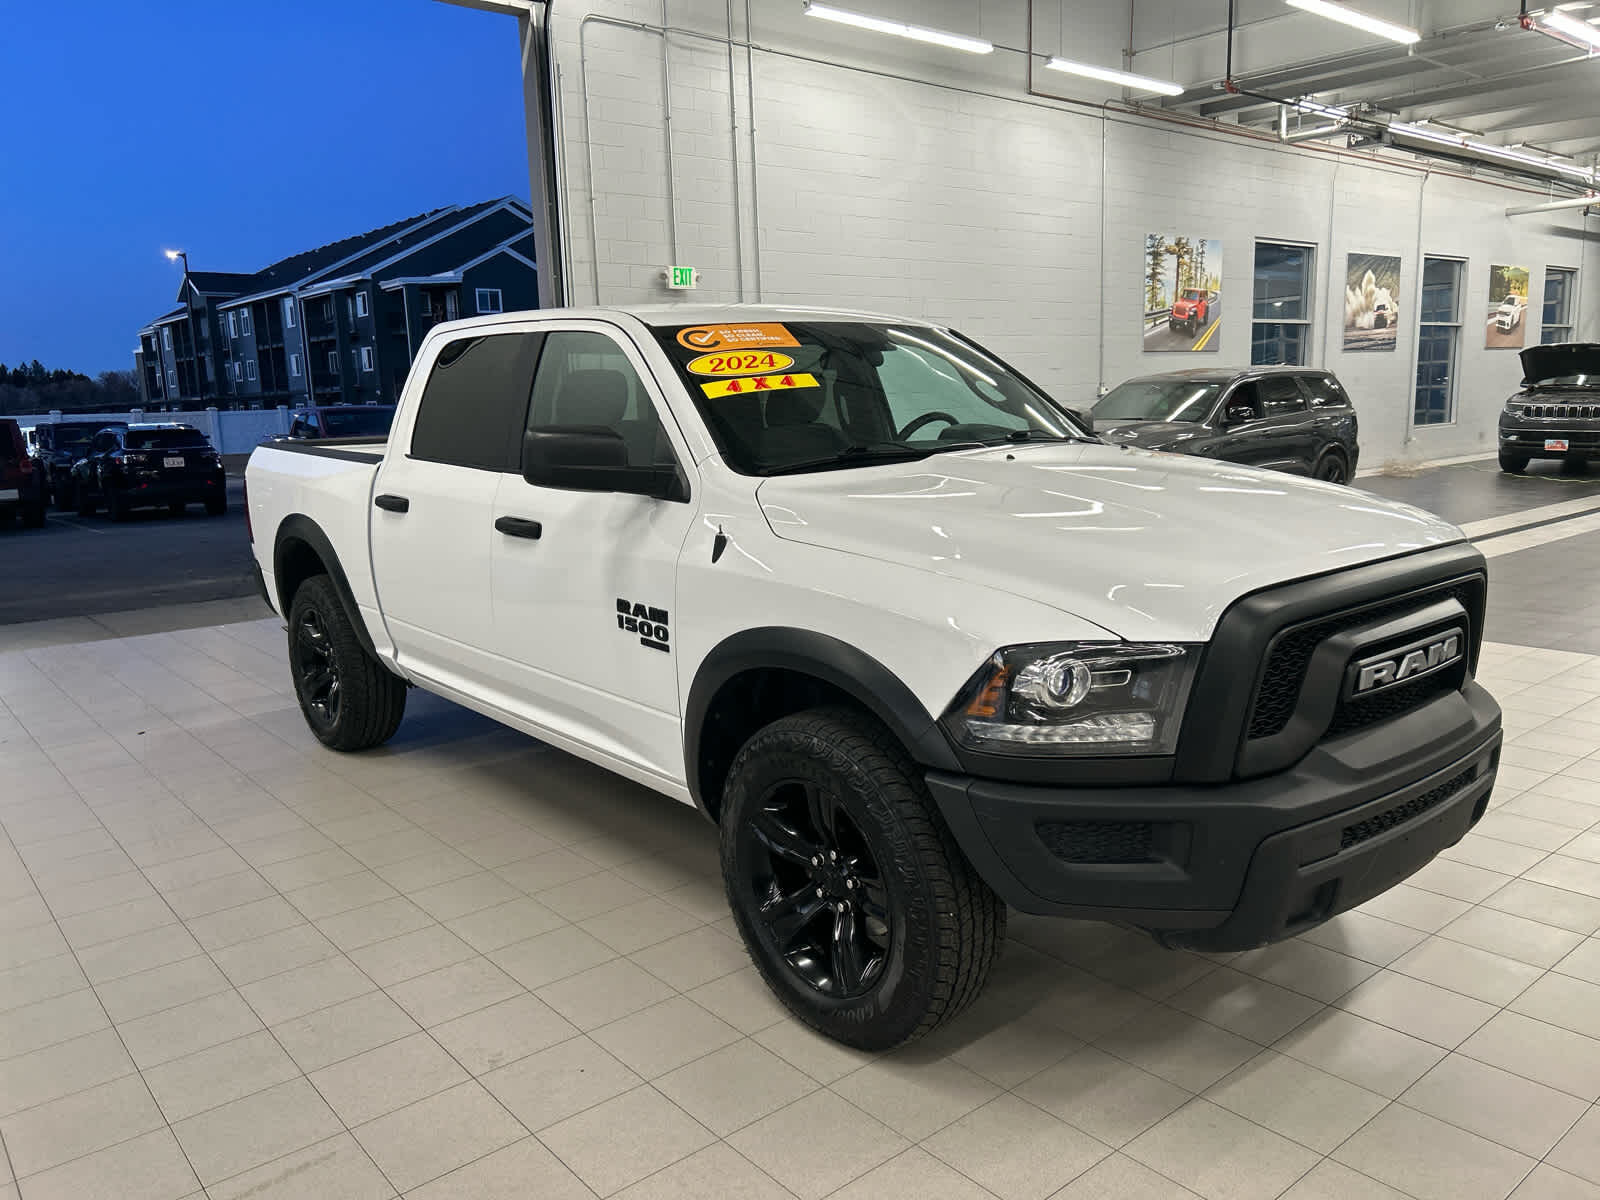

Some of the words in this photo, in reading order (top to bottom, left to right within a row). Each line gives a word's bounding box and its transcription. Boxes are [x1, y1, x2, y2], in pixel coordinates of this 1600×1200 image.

[673, 267, 693, 286] EXIT
[709, 353, 777, 373] 2024
[726, 379, 742, 393] 4
[780, 375, 796, 387] 4
[616, 598, 669, 627] RAM
[617, 614, 669, 642] 1500
[1359, 636, 1458, 691] RAM
